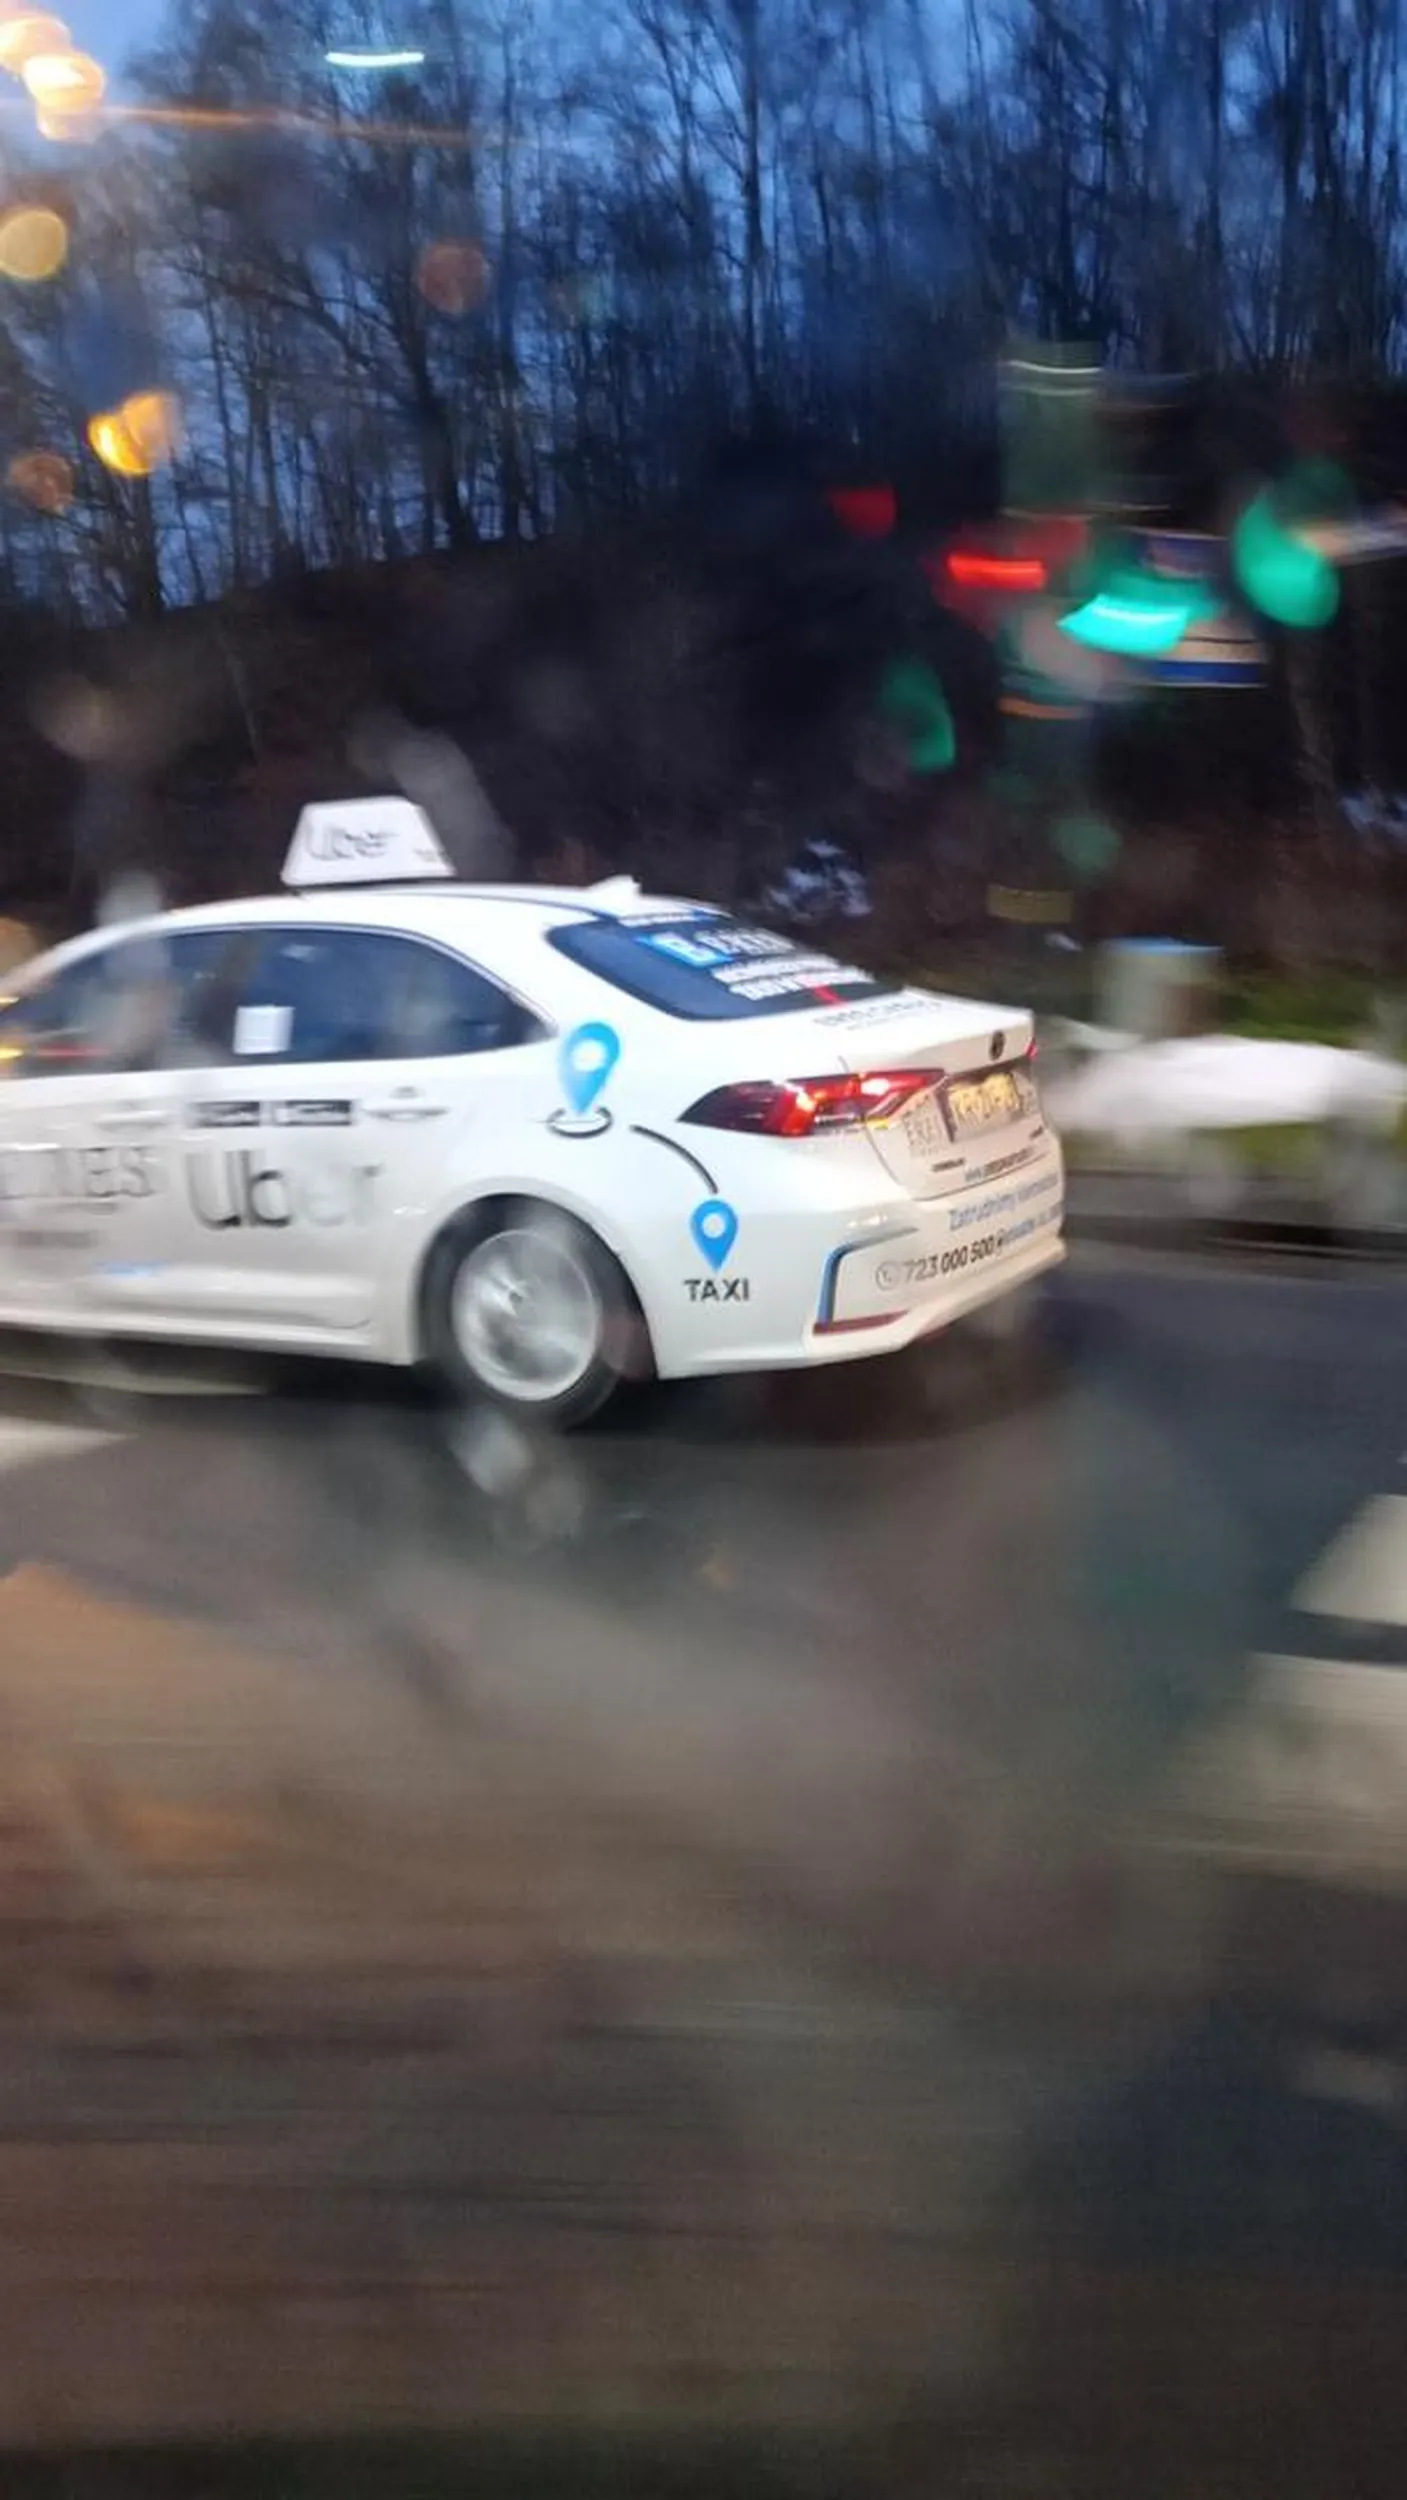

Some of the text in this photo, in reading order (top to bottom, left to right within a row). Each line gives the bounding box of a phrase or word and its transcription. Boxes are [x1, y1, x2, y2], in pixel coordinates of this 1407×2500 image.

[184, 1149, 384, 1231] Uber
[903, 1233, 995, 1283] 723 000 500
[683, 1277, 750, 1302] TAXI
